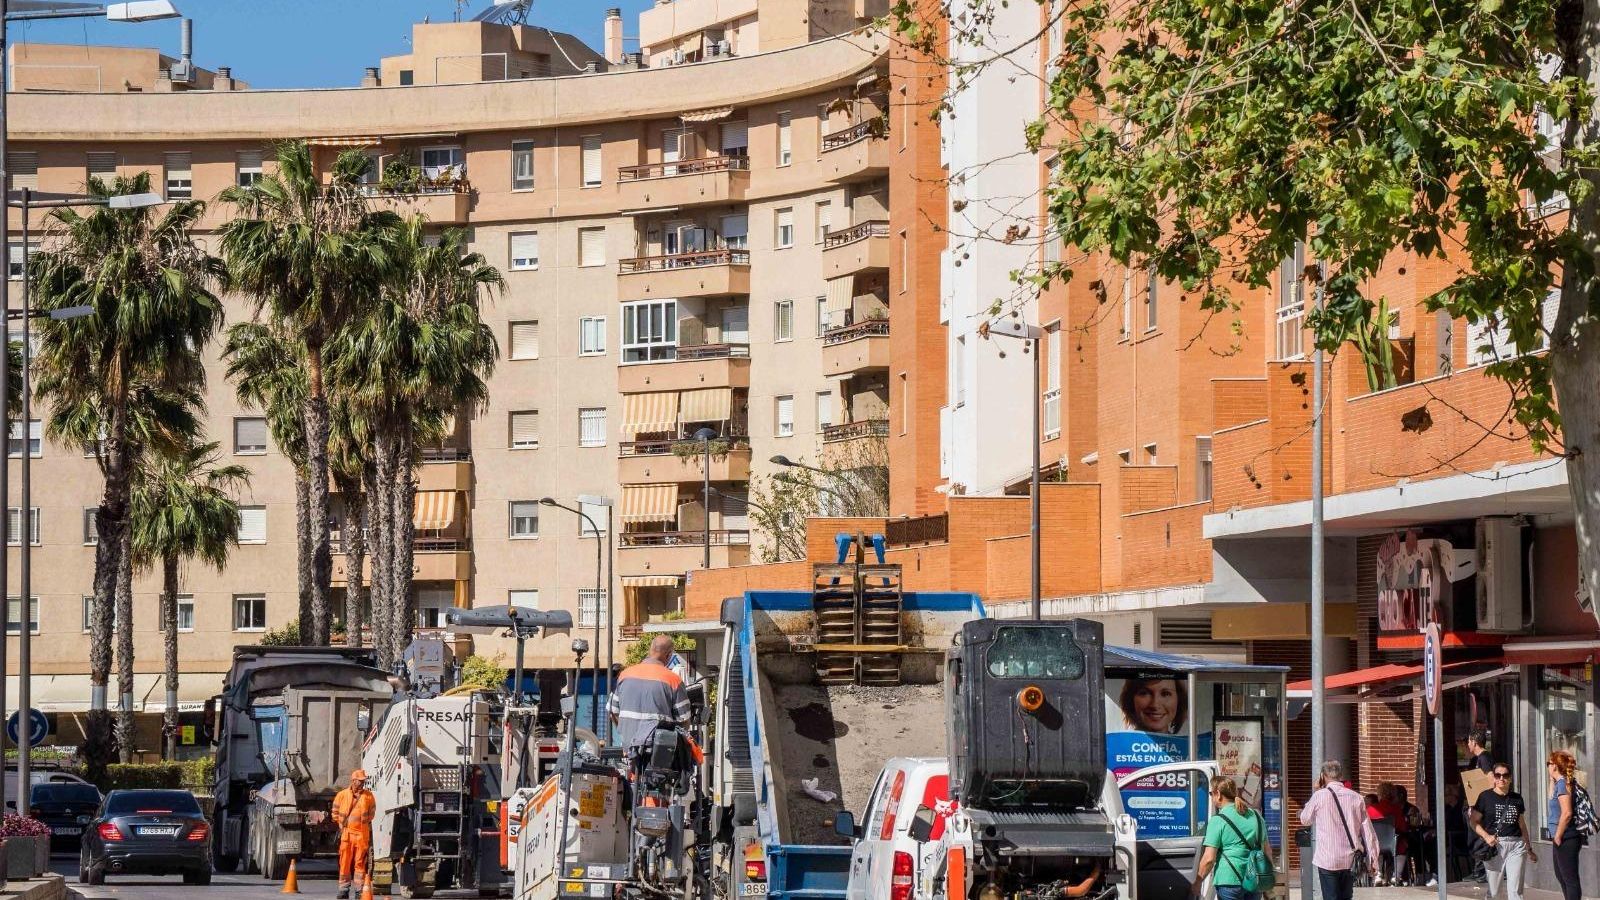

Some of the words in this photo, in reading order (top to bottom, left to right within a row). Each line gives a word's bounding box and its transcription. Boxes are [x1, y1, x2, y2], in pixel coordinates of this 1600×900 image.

[417, 711, 474, 722] FRESAR
[1116, 753, 1143, 763] ESTÁS
[1144, 755, 1156, 763] EN
[746, 884, 767, 894] 869
